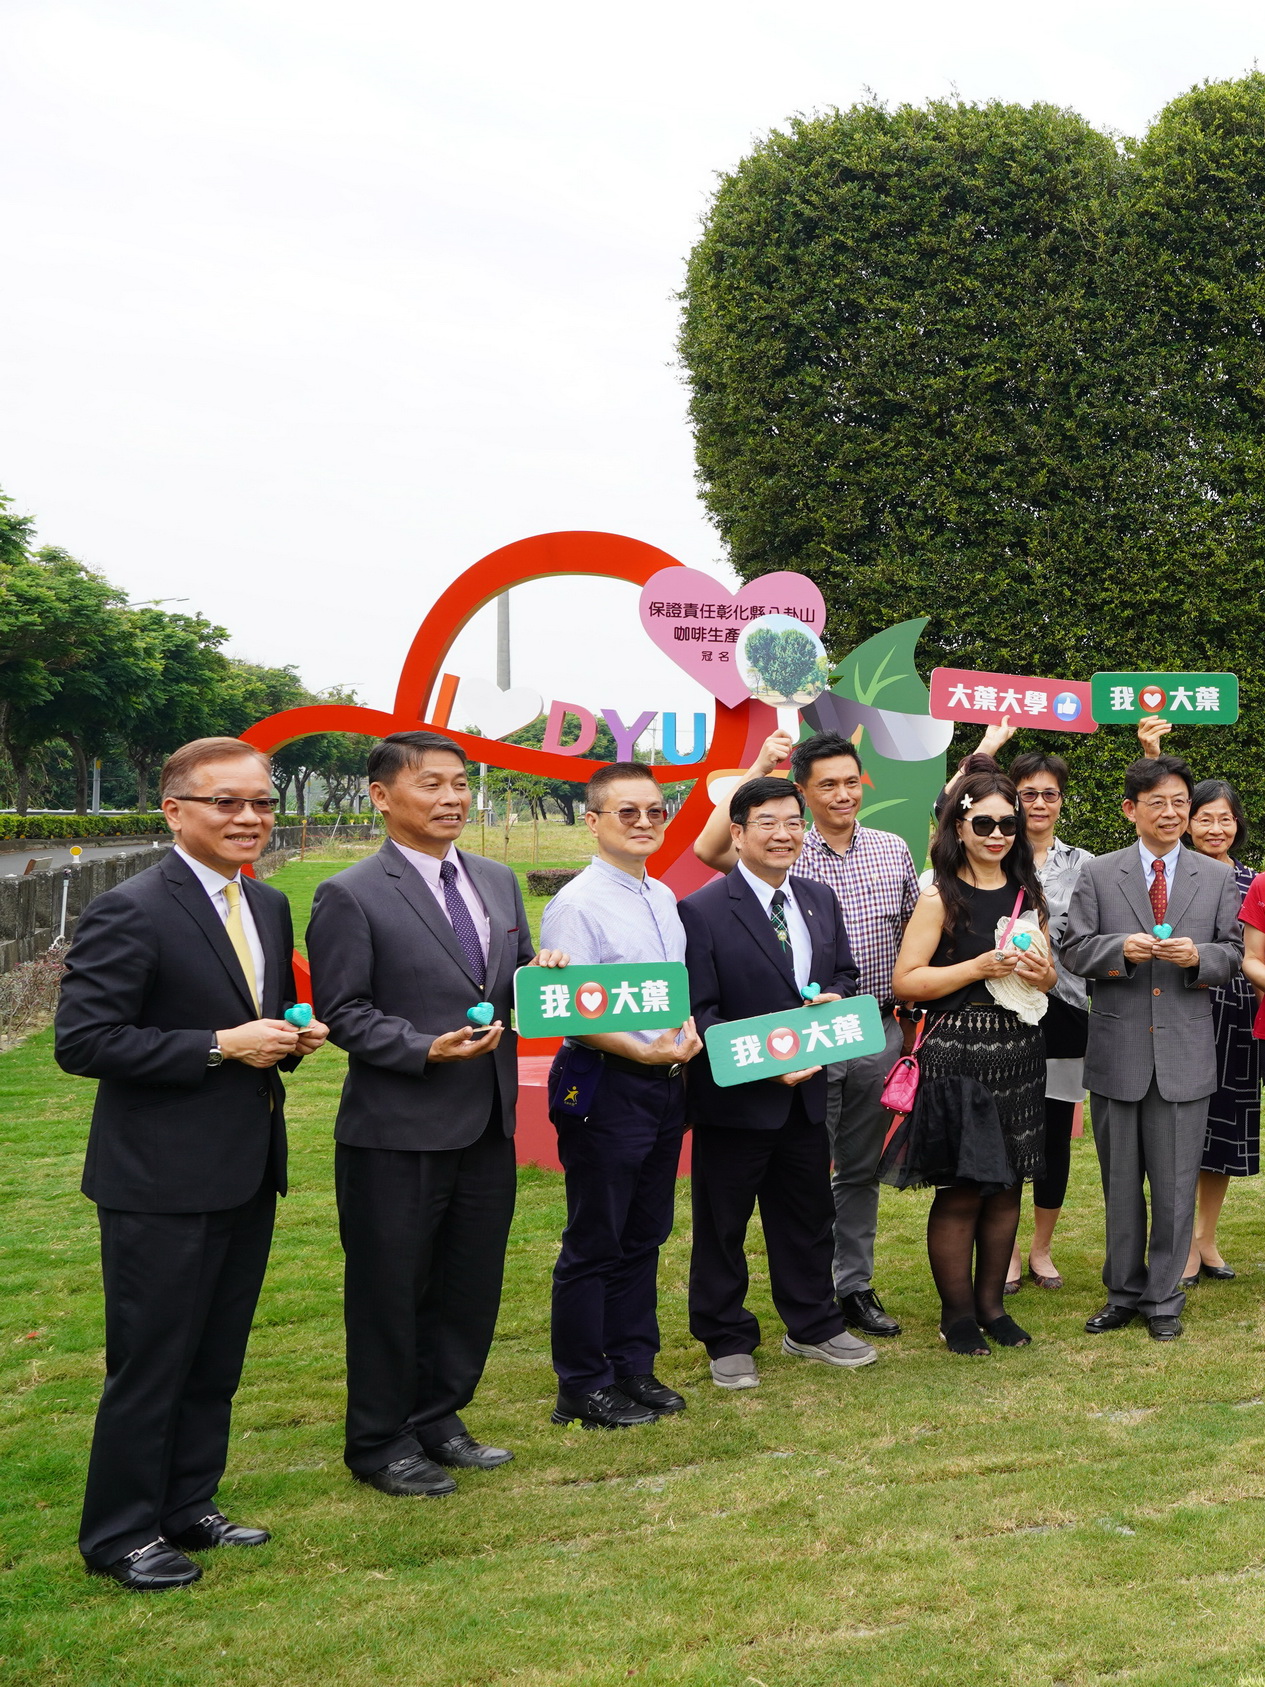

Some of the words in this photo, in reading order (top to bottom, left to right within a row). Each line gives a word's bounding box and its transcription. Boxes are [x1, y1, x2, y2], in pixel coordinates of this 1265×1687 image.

[673, 625, 740, 644] 咖啡生產
[948, 683, 1047, 716] 大葉大學
[1110, 686, 1135, 711] 我
[1169, 686, 1220, 711] 大葉
[541, 699, 706, 766] DYU
[540, 984, 571, 1019] 我
[611, 979, 670, 1015] 大葉
[730, 1034, 765, 1068] 我
[801, 1013, 865, 1053] 大葉
